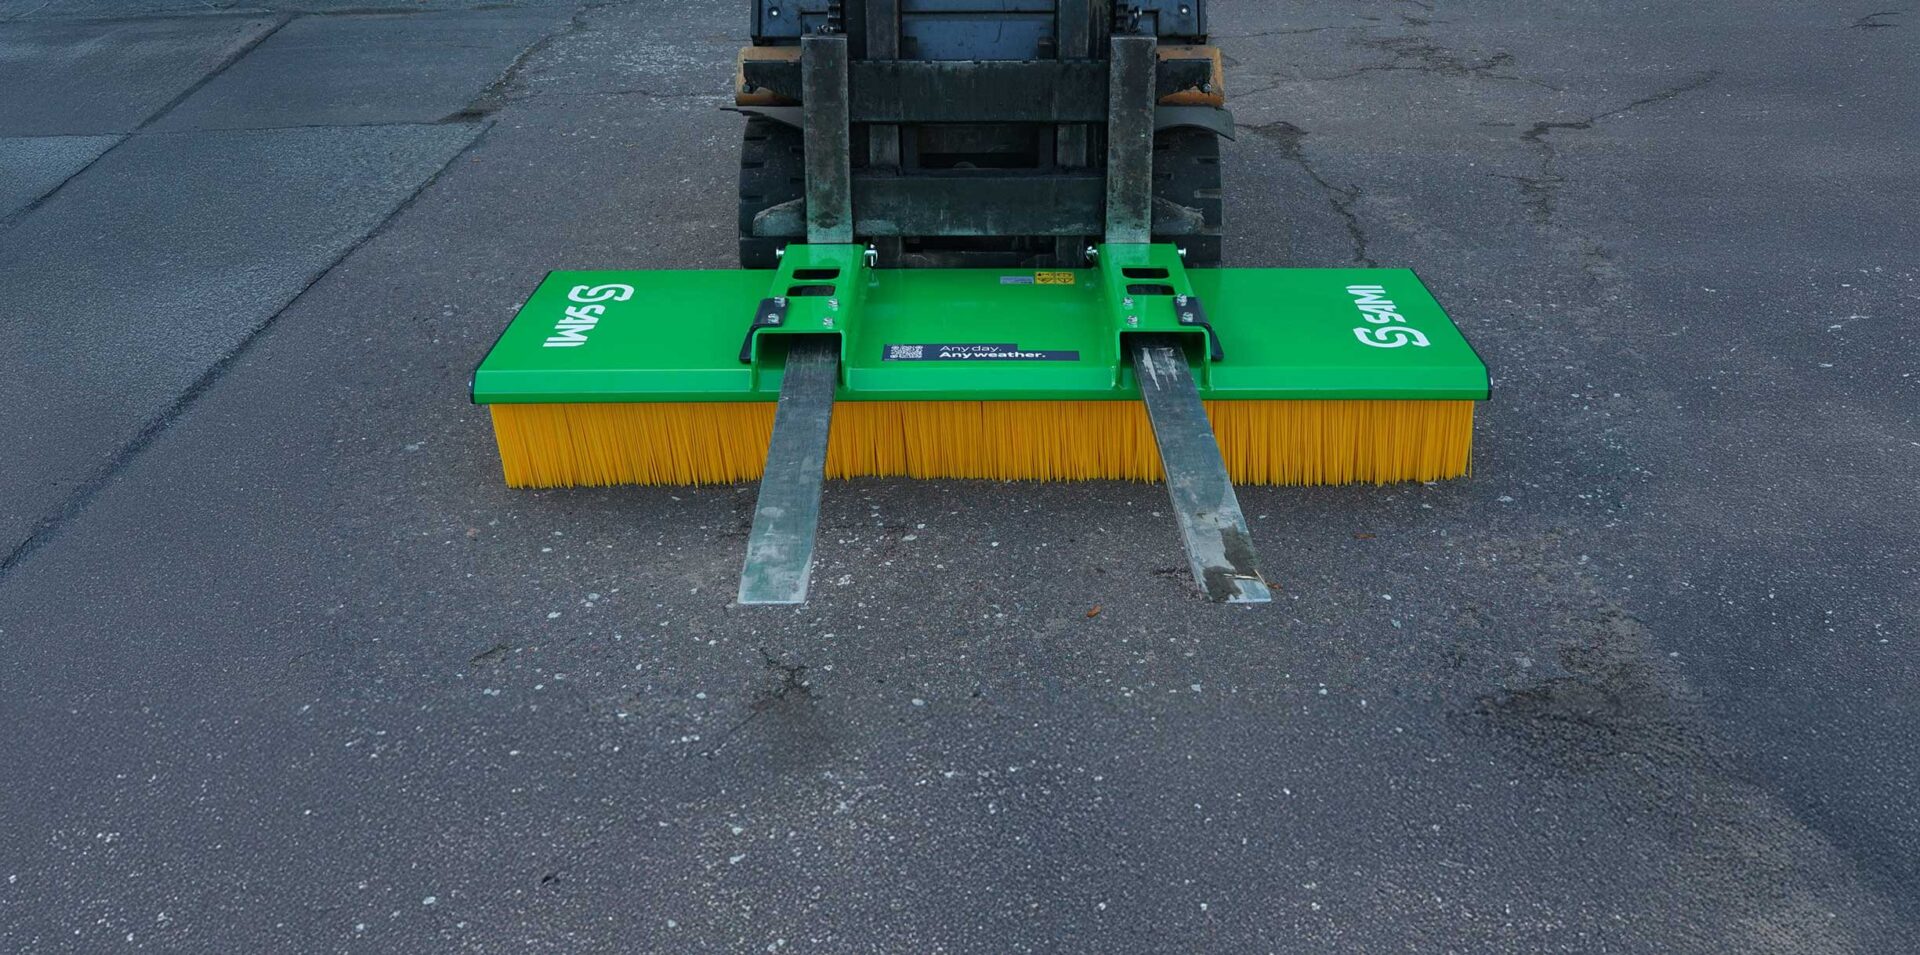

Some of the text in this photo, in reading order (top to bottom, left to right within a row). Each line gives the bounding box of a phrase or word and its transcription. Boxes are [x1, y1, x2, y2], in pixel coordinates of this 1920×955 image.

[1345, 284, 1407, 324] SAMI
[542, 304, 606, 347] SAMI
[939, 351, 972, 359] Any
